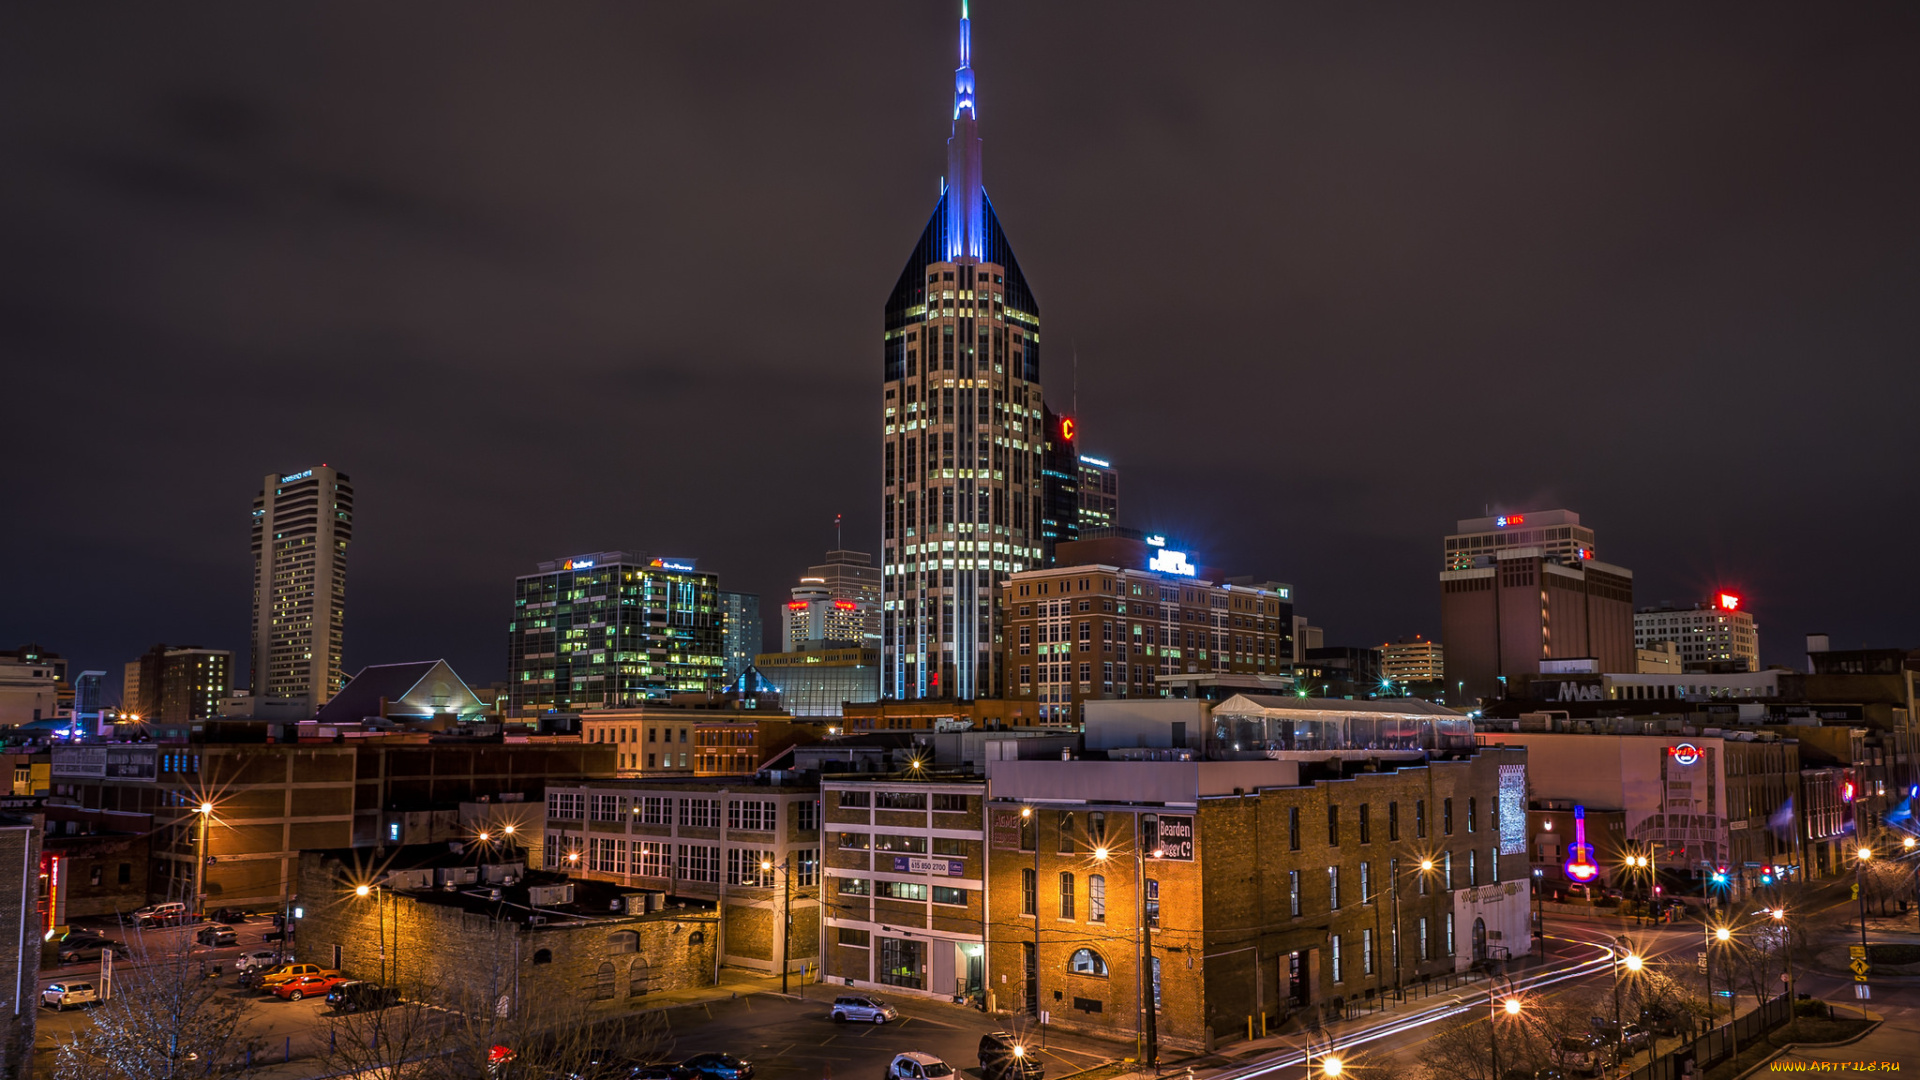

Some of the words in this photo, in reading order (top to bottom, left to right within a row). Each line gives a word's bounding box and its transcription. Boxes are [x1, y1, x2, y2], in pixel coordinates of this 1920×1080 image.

[1063, 419, 1073, 439] C
[1507, 515, 1523, 525] UBS
[1160, 820, 1190, 837] Bearden
[921, 862, 931, 870] 850
[932, 863, 946, 871] 2700
